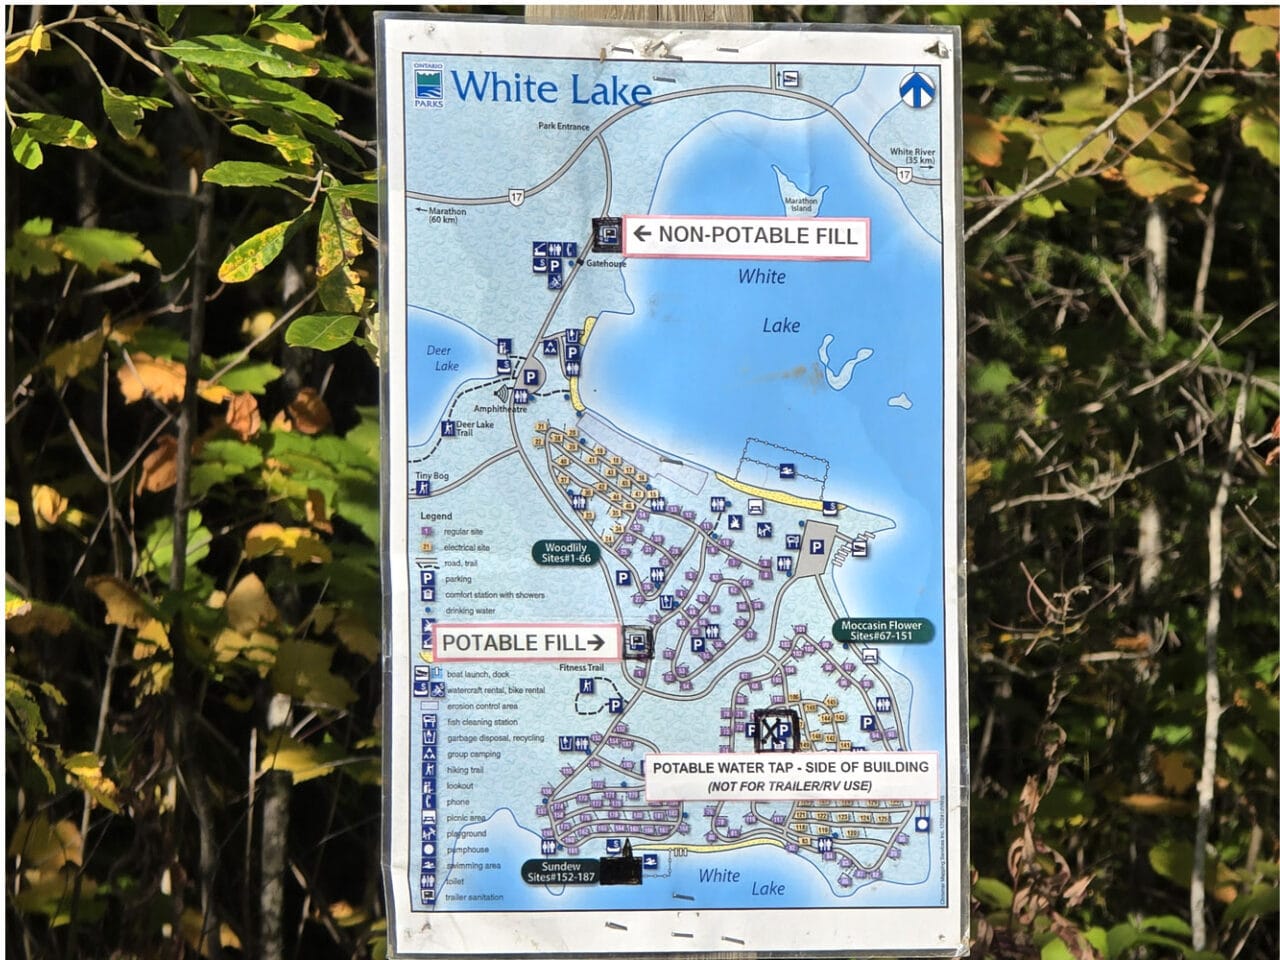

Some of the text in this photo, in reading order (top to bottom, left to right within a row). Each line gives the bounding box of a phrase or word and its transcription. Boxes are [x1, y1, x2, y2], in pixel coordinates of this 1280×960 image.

[451, 71, 652, 107] White Lake
[538, 122, 590, 131] Park Entrance
[890, 147, 936, 156] White River
[905, 157, 936, 165] (35 km)
[899, 170, 910, 179] 17
[511, 192, 522, 201] 17
[785, 197, 818, 205] Marathon
[429, 207, 467, 216] Marathon
[791, 205, 812, 213] Island
[429, 216, 458, 224] (60 km)
[659, 225, 858, 245] NON-POTABLE FILL
[586, 260, 627, 268] Gatehouse
[739, 268, 786, 285] White
[763, 317, 801, 333] Lake
[427, 345, 451, 356] Deer
[435, 361, 459, 371] Lake
[473, 405, 528, 414] Amphitheatre
[456, 421, 494, 429] Deer Lake
[416, 472, 449, 481] Tiny Bog
[421, 512, 452, 521] Legend
[444, 528, 469, 536] regular
[545, 543, 587, 553] Woodlily
[542, 553, 591, 563] Sites#1-66
[445, 576, 472, 584] parking
[445, 591, 545, 599] comfort station with showers
[445, 607, 479, 615] drinking
[841, 621, 922, 630] Moccasin Flower
[850, 632, 912, 641] Sites#67-151
[443, 634, 587, 651] POTABLE FILL
[559, 663, 604, 671] Fitness Trail
[464, 671, 491, 679] launch,
[484, 687, 507, 695] rental,
[462, 719, 492, 727] cleaning
[447, 735, 544, 743] garbage disposal, recycling
[447, 767, 469, 775] hiking
[653, 762, 715, 773] POTABLE
[718, 762, 764, 773] WATER
[767, 762, 793, 773] TAP
[805, 761, 836, 773] SIDE
[840, 761, 860, 773] OF
[863, 761, 929, 772] BUILDING
[708, 781, 872, 793] (NOT FOR TRAILER/RV USE)
[447, 799, 470, 807] phone
[447, 815, 468, 823] picnic
[447, 831, 487, 839] playground
[447, 847, 489, 855] pumphouse
[447, 863, 483, 871] swimming
[542, 862, 581, 872] Sundew
[528, 872, 595, 882] Sites#152-187
[700, 868, 741, 883] White
[752, 881, 786, 896] Lake
